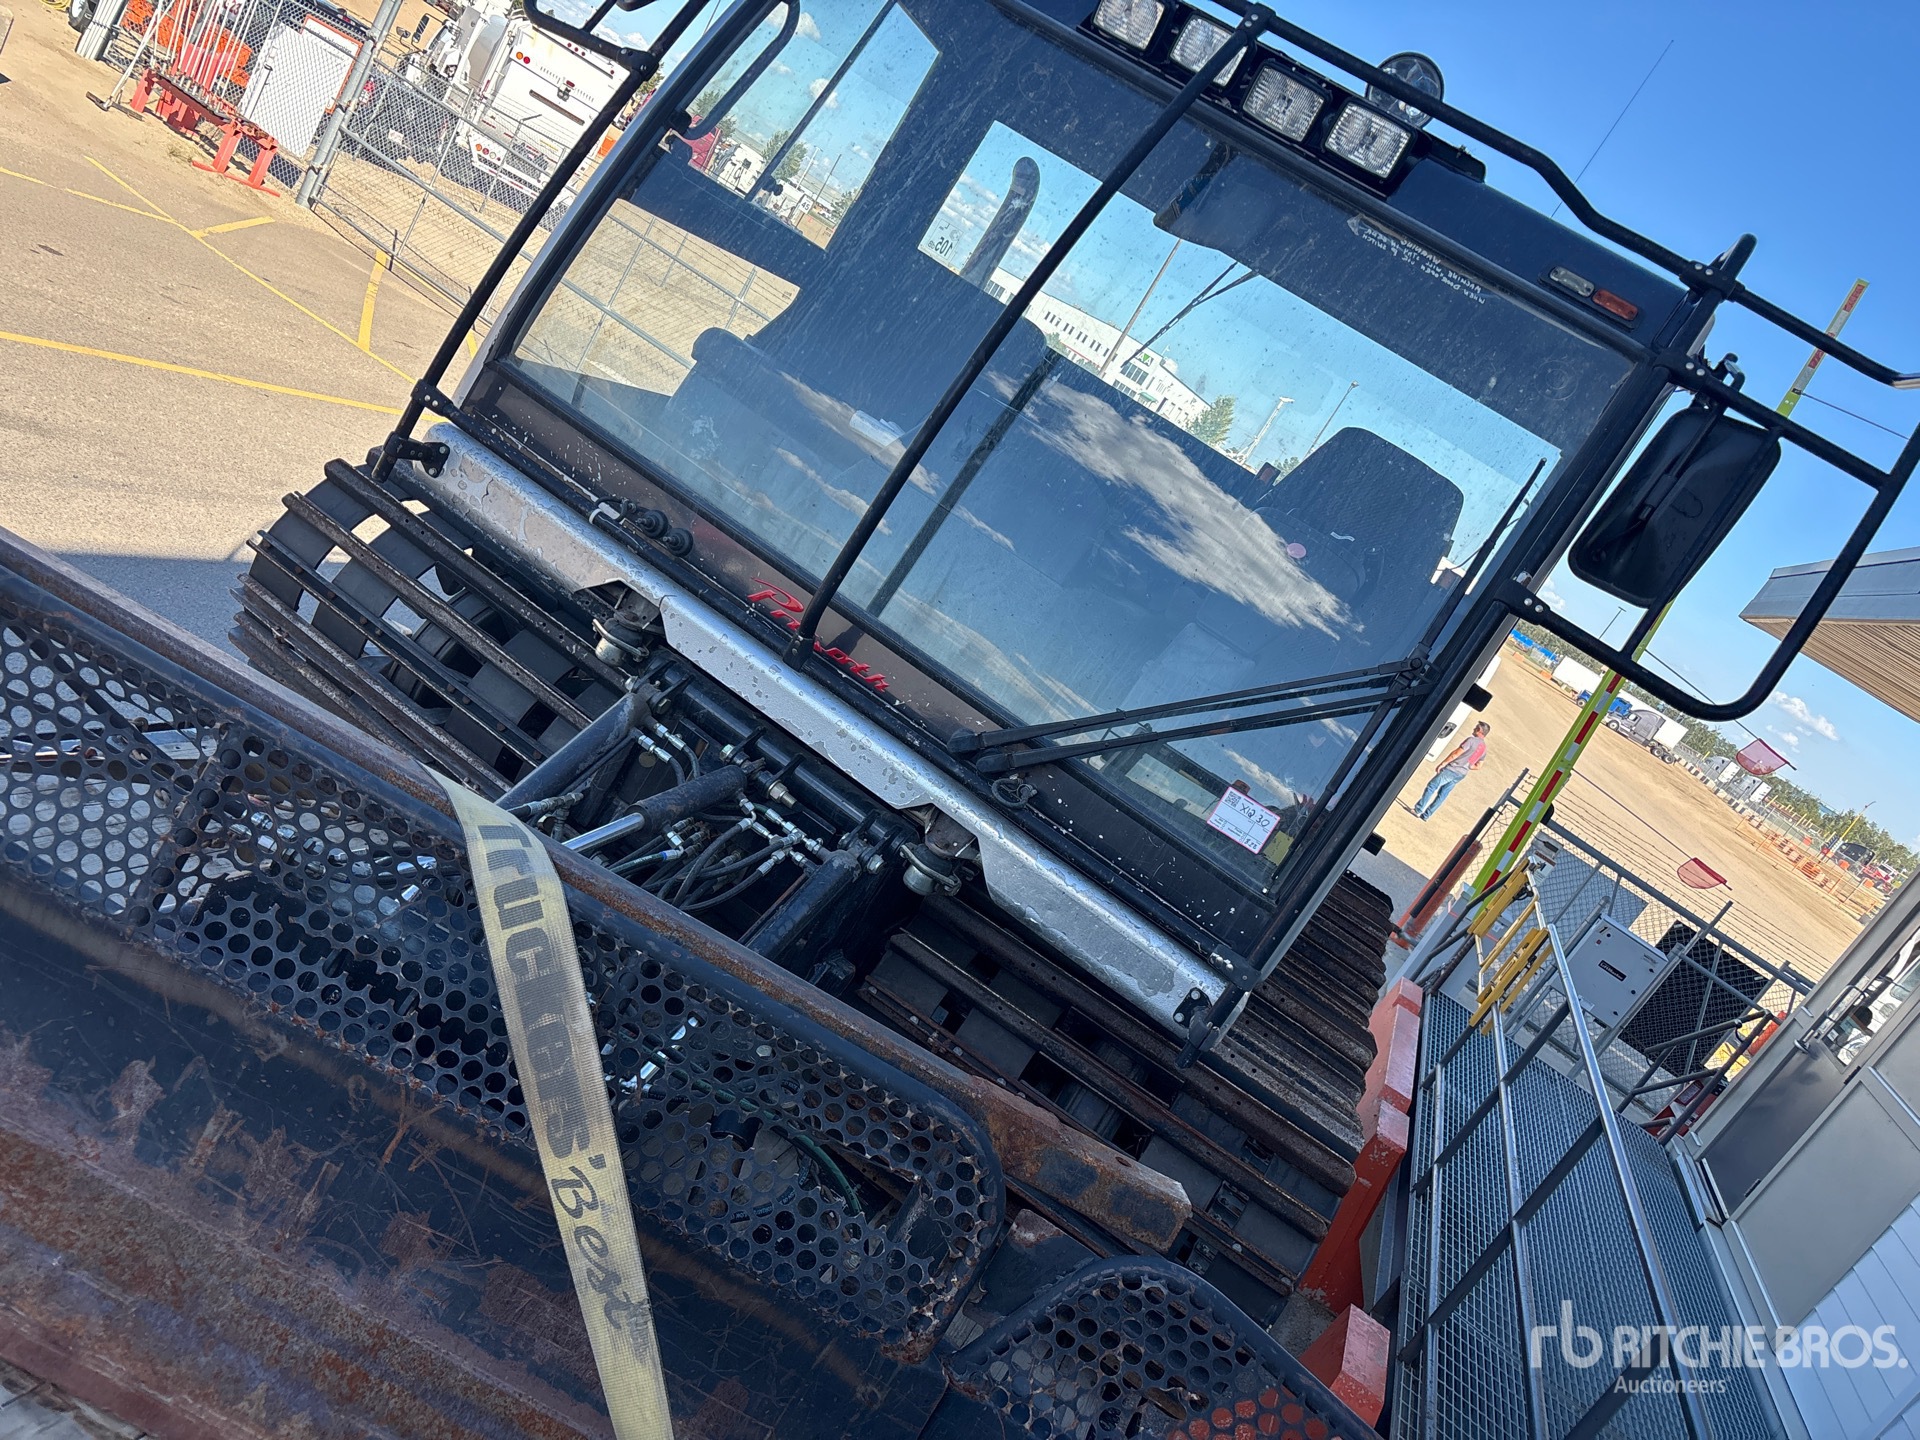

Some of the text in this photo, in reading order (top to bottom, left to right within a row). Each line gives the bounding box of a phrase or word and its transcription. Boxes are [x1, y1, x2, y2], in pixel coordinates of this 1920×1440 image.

[801, 202, 810, 210] 45
[747, 577, 890, 693] Proth
[551, 1166, 649, 1330] Best
